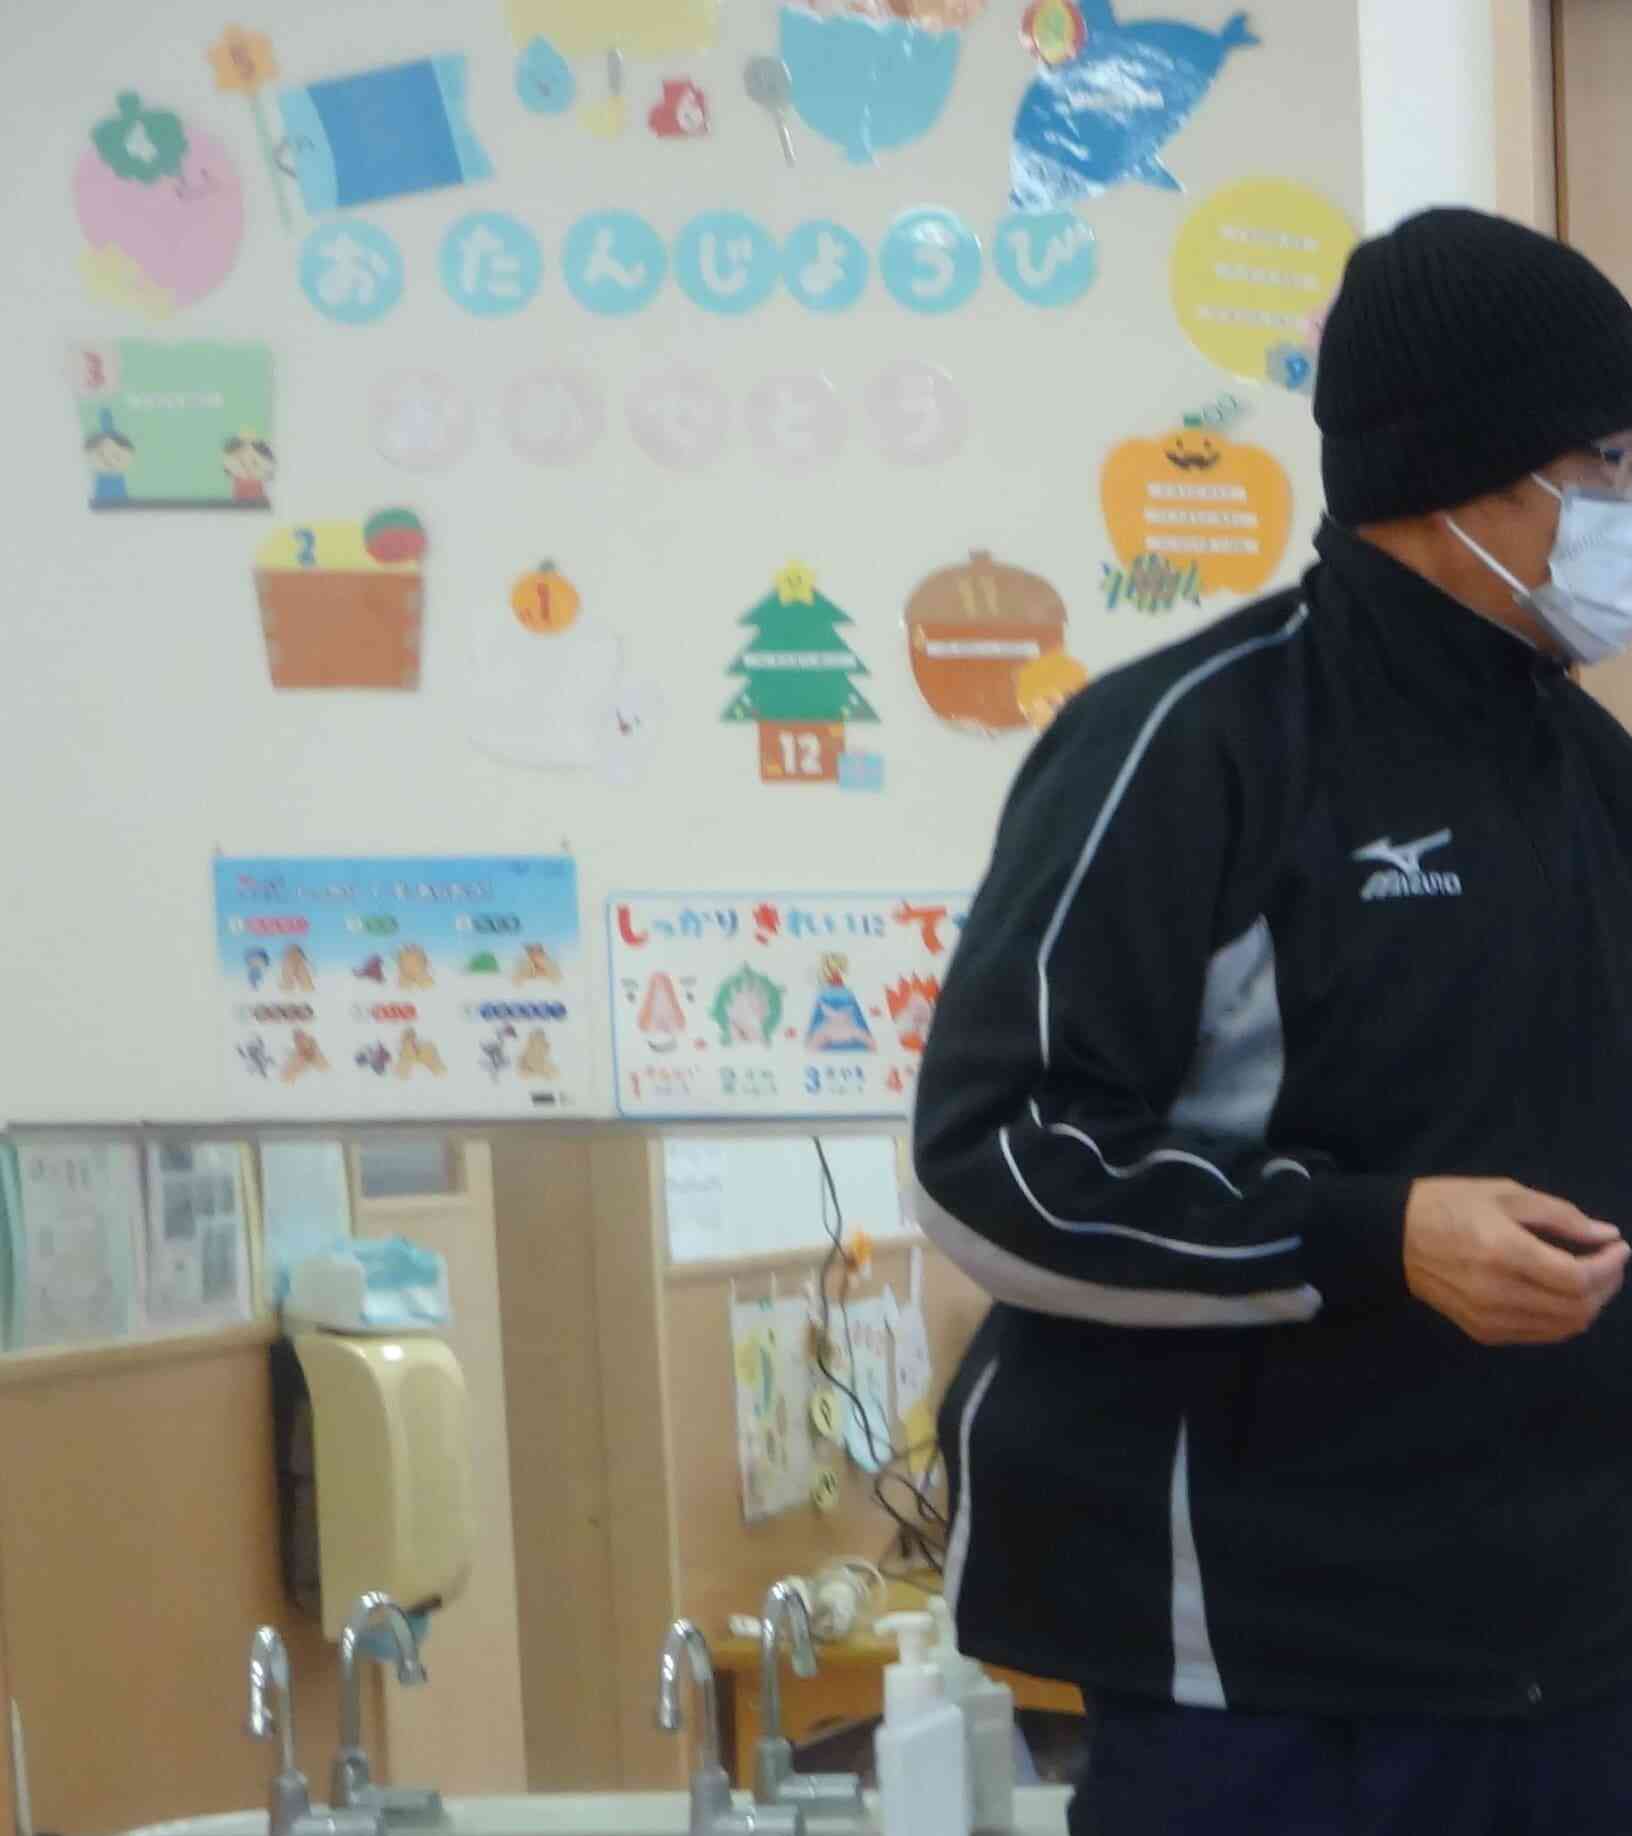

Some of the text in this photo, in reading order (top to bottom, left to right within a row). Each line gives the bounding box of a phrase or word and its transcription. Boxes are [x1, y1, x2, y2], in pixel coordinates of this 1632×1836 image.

[314, 222, 1094, 306] おたんじょうび
[290, 528, 317, 568] 2
[778, 731, 823, 775] 12
